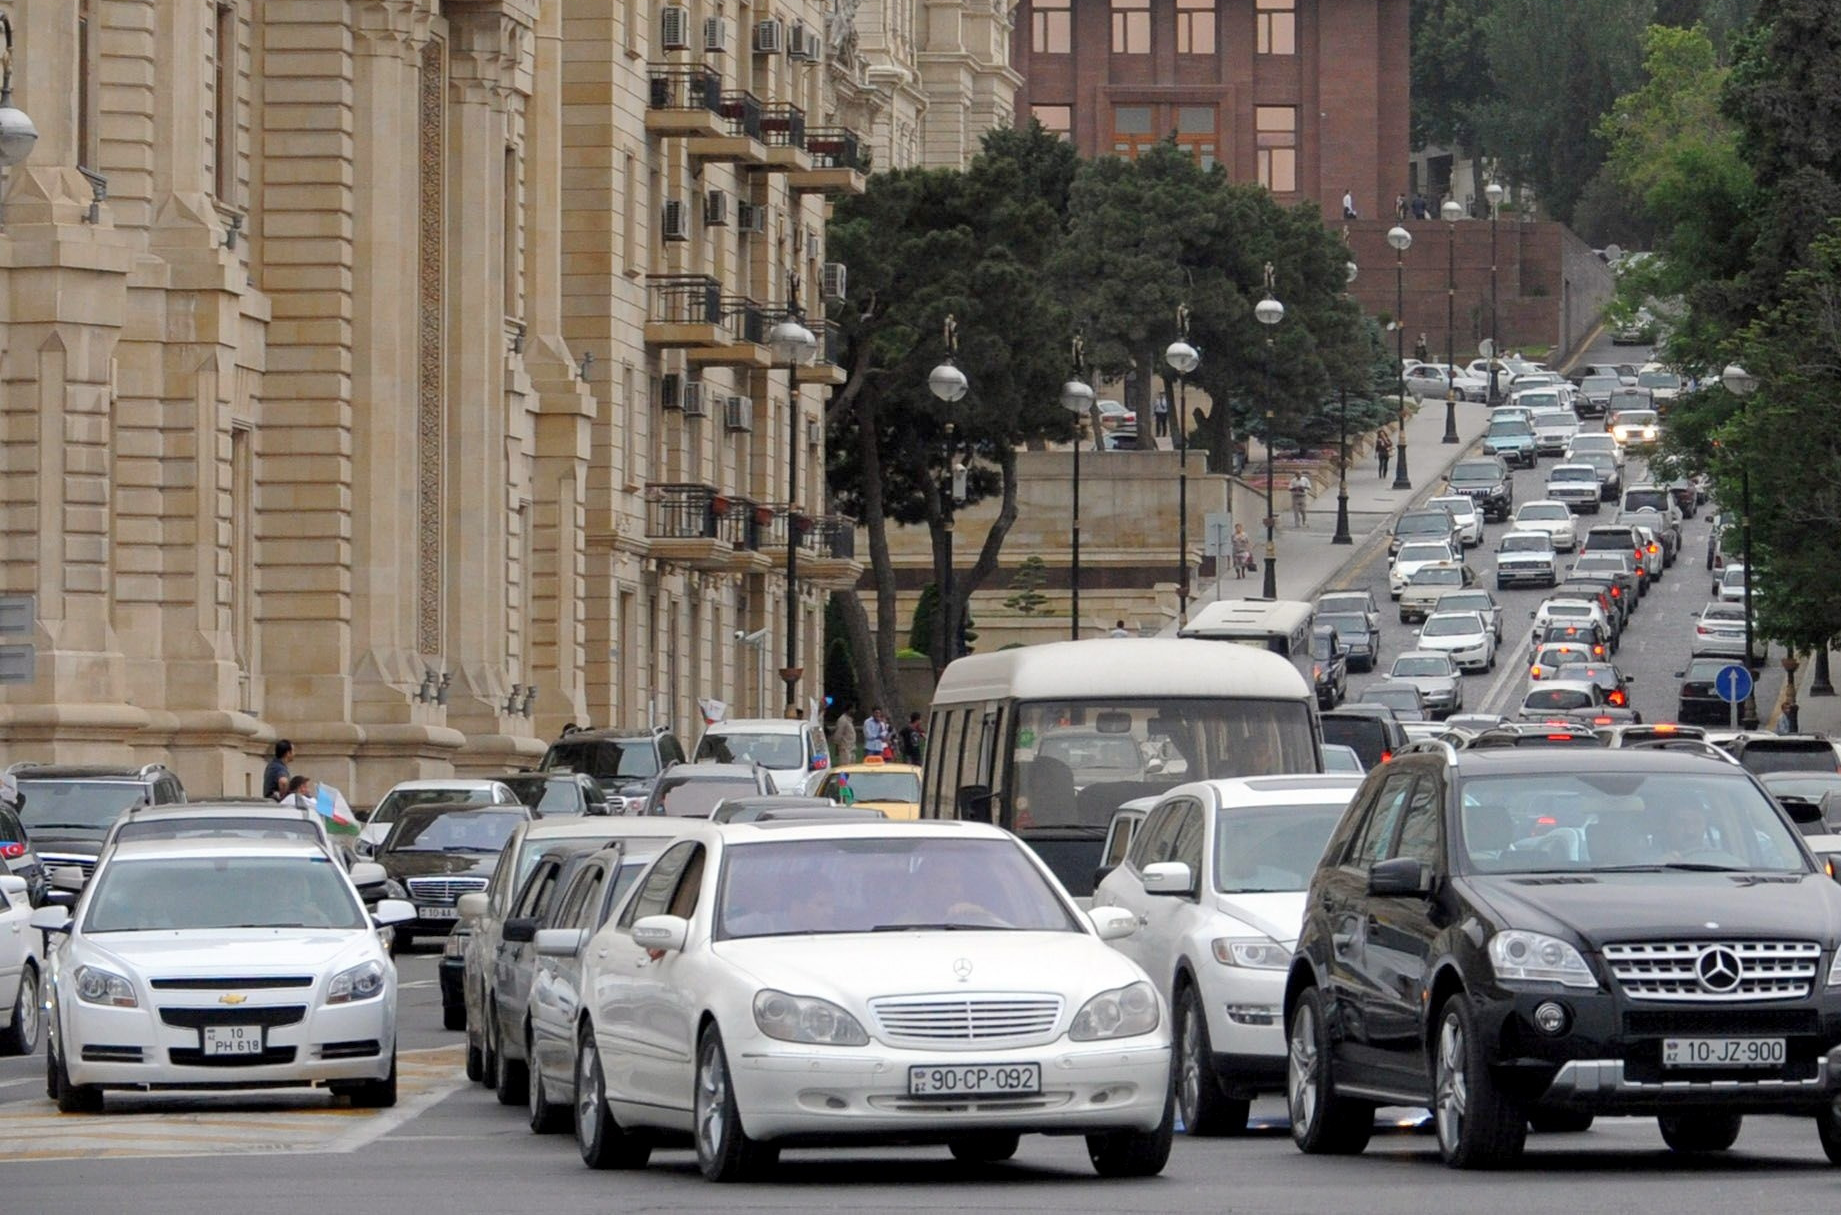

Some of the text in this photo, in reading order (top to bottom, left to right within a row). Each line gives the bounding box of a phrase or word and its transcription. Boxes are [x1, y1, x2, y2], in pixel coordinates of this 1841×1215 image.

[231, 1028, 244, 1039] 10
[215, 1041, 233, 1052] PH
[1688, 1041, 1783, 1062] 10-JZ-900
[931, 1068, 1034, 1090] 90-CP-092
